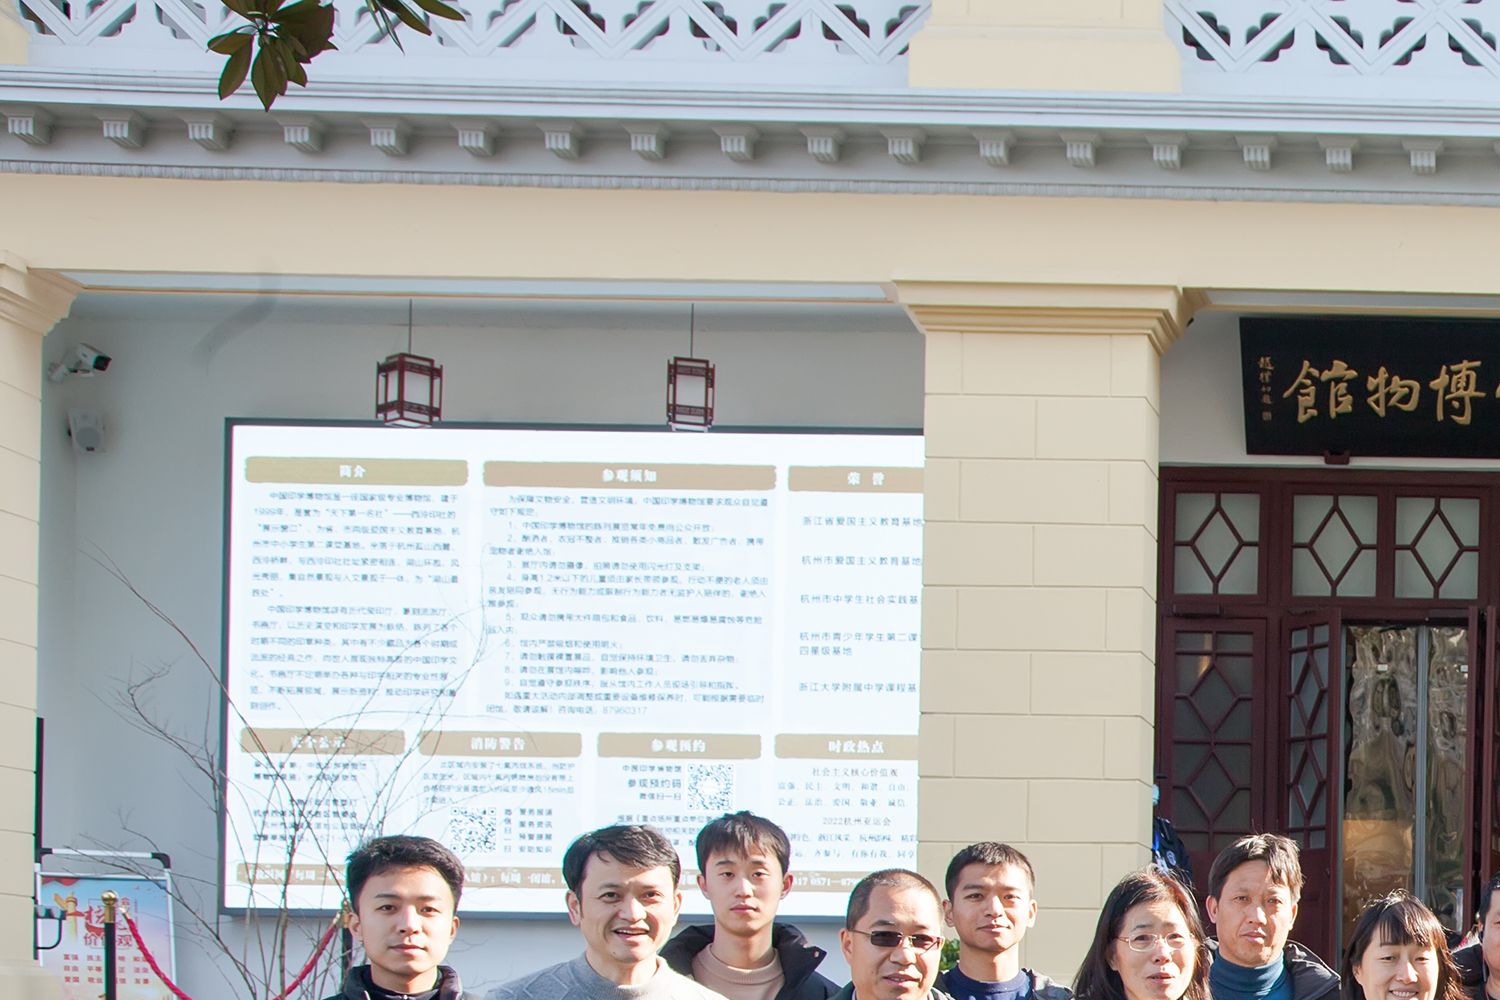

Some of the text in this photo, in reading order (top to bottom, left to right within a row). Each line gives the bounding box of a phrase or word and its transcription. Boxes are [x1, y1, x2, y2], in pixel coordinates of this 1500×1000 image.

[338, 464, 366, 478] 简介
[601, 468, 657, 484] 参观须知
[802, 516, 922, 526] 浙江省爱国主义教育基地
[801, 555, 922, 566] 杭州市爱国主义教育基地
[471, 737, 525, 751] 消防警告
[651, 738, 706, 752] 参观预约
[828, 740, 884, 753] 时政热点
[812, 768, 898, 777] 社会主义核心价值观
[822, 817, 892, 826] 2022杭州亚运会
[84, 933, 132, 947] 价观
